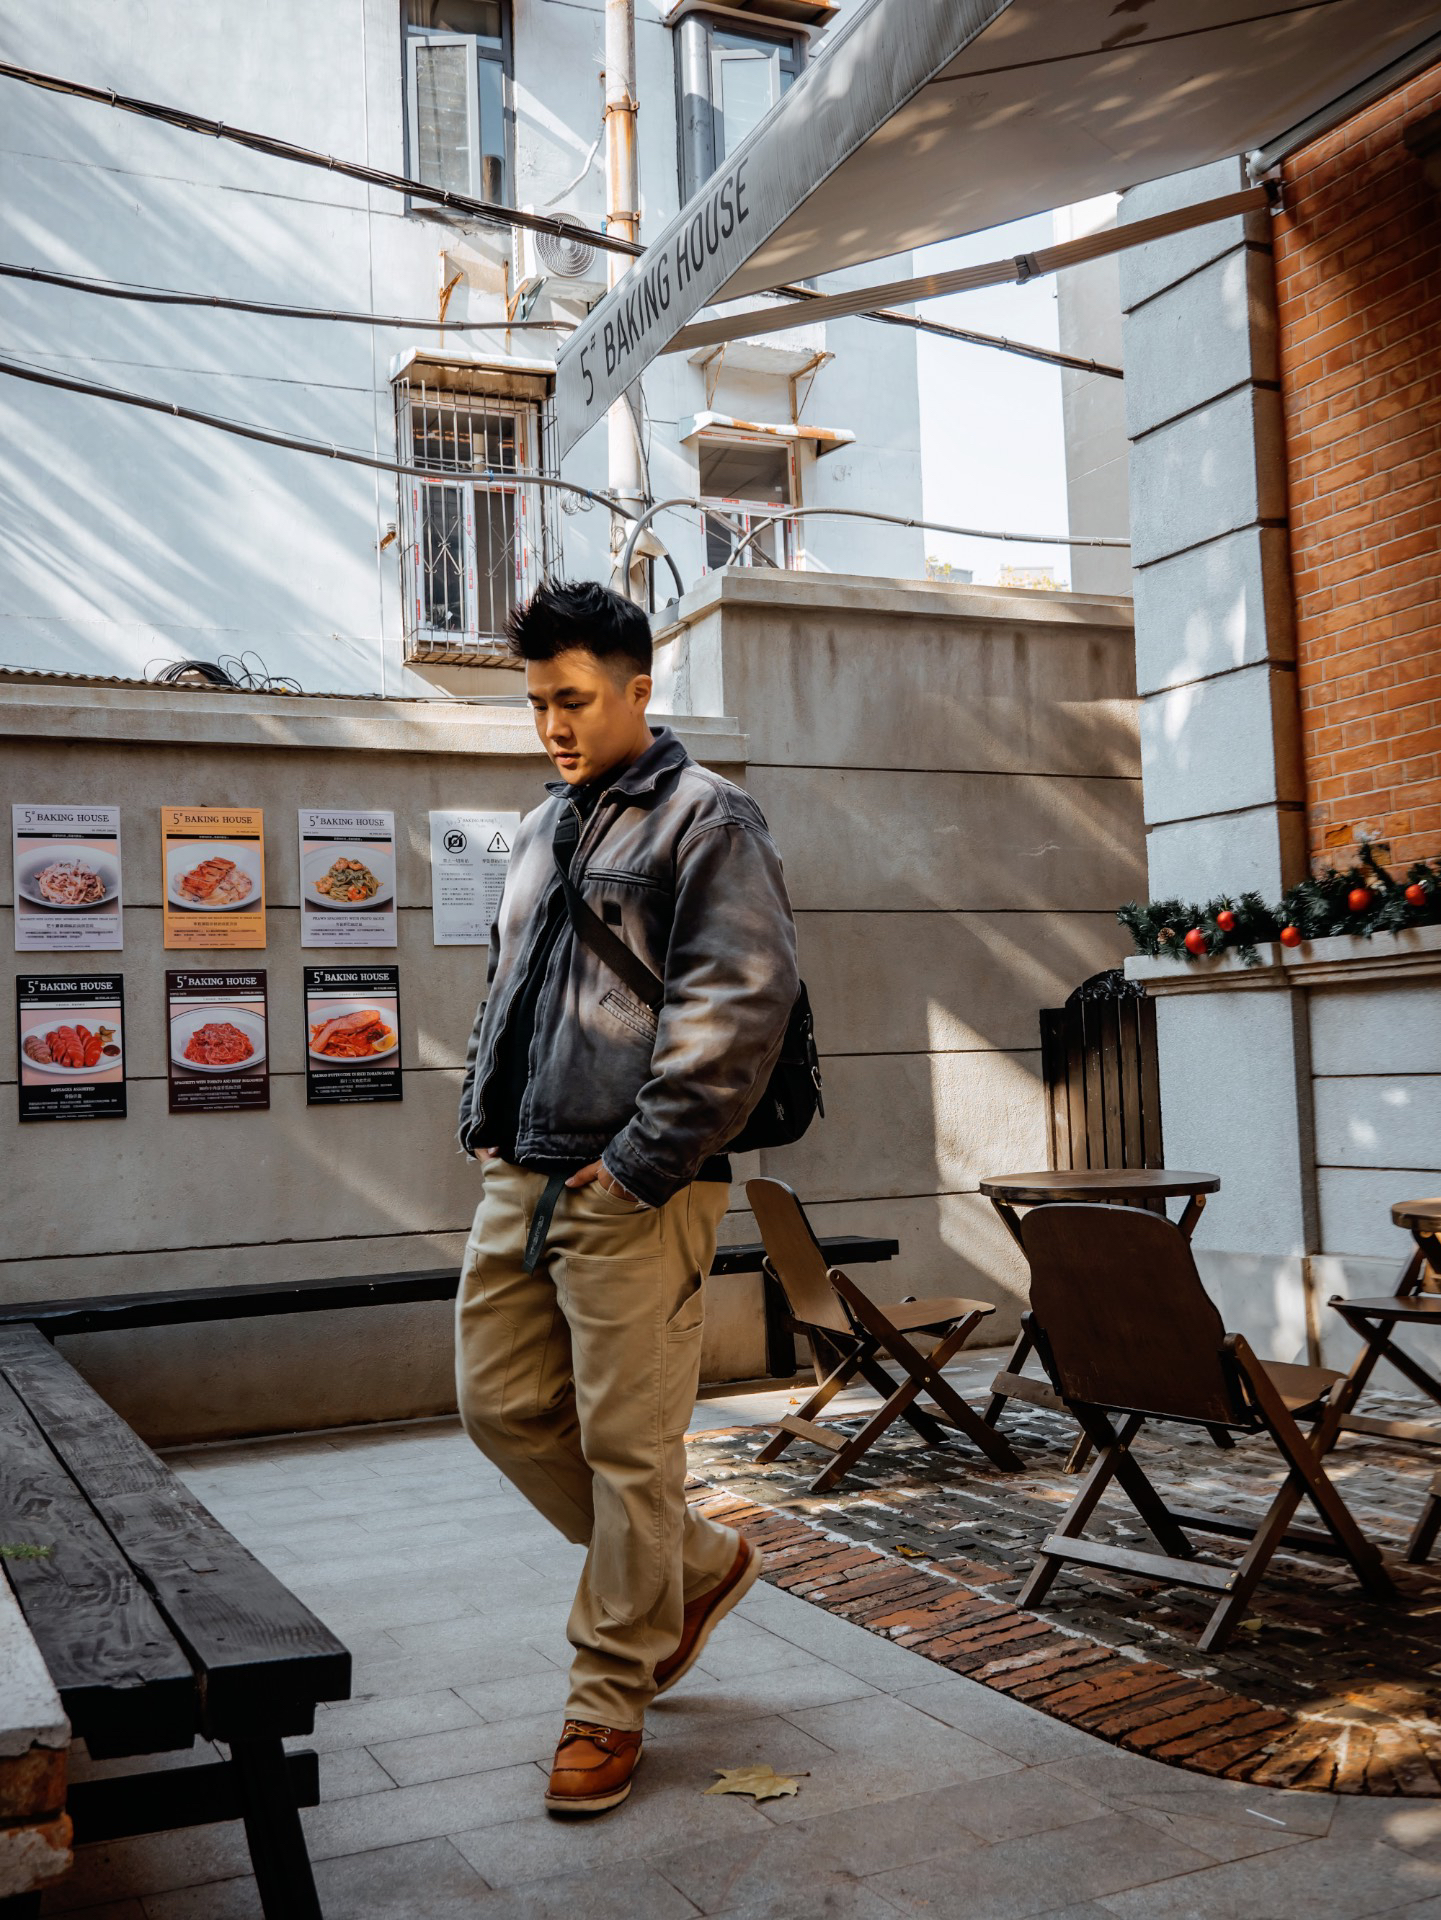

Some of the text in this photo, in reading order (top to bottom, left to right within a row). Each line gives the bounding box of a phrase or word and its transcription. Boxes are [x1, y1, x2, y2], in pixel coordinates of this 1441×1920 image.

[603, 252, 670, 377] BAKING
[676, 157, 749, 291] HOUSE
[37, 813, 74, 822] BAKING
[76, 814, 110, 823] HOUSE
[184, 815, 219, 823] BAKING
[222, 816, 253, 824] HOUSE
[320, 817, 353, 826] BAKING
[356, 818, 385, 827] HOUSE
[188, 977, 224, 986] BAKING
[226, 976, 258, 985] HOUSE
[324, 973, 358, 982] BAKING
[360, 972, 390, 981] HOUSE
[40, 982, 78, 991] BAKING
[80, 981, 113, 990] HOUSE
